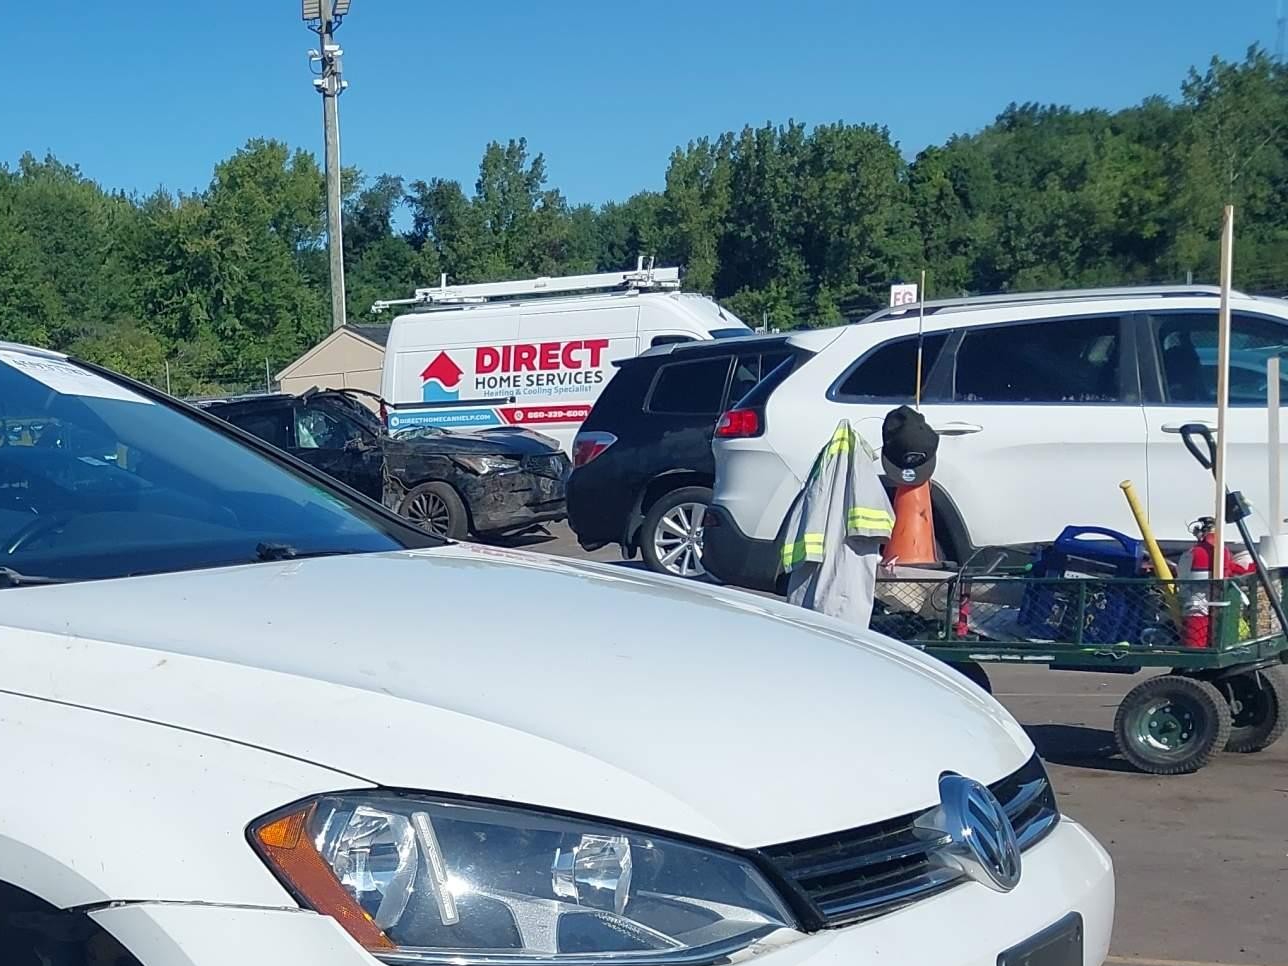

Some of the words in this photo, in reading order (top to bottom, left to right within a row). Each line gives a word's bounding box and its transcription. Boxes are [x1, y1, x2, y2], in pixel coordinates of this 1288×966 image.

[475, 338, 609, 374] DIRECT
[475, 375, 521, 390] HOME
[526, 370, 604, 388] SERVICES
[483, 389, 513, 397] Heating
[523, 386, 552, 396] Cooling
[554, 385, 592, 394] Specialist
